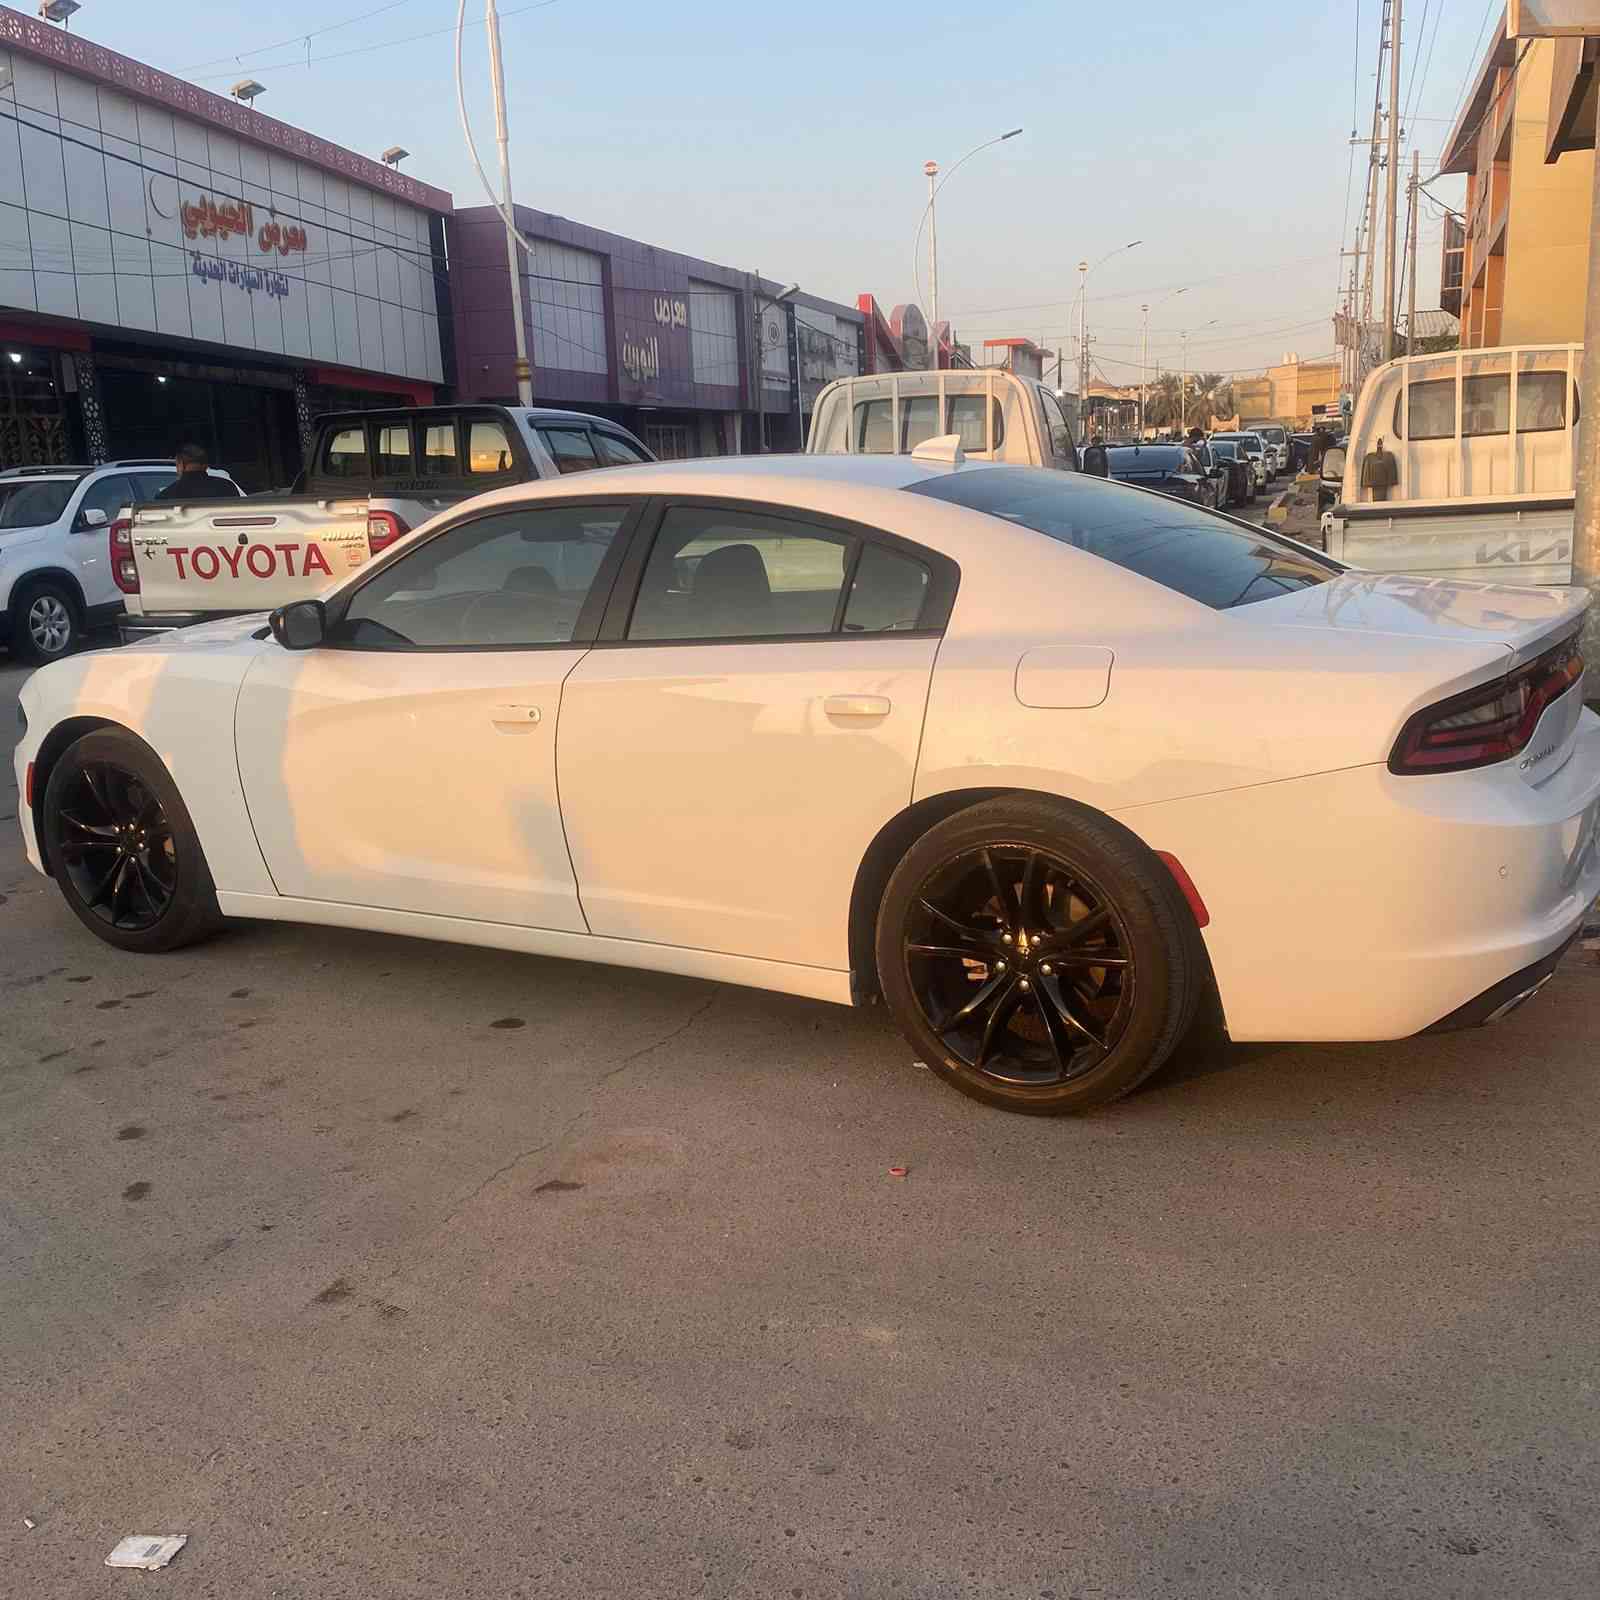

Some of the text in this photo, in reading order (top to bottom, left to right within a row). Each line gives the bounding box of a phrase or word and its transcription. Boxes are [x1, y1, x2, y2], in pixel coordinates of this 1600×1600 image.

[258, 205, 307, 256] معرض
[654, 293, 687, 331] معرض
[167, 543, 333, 580] TOYOTA
